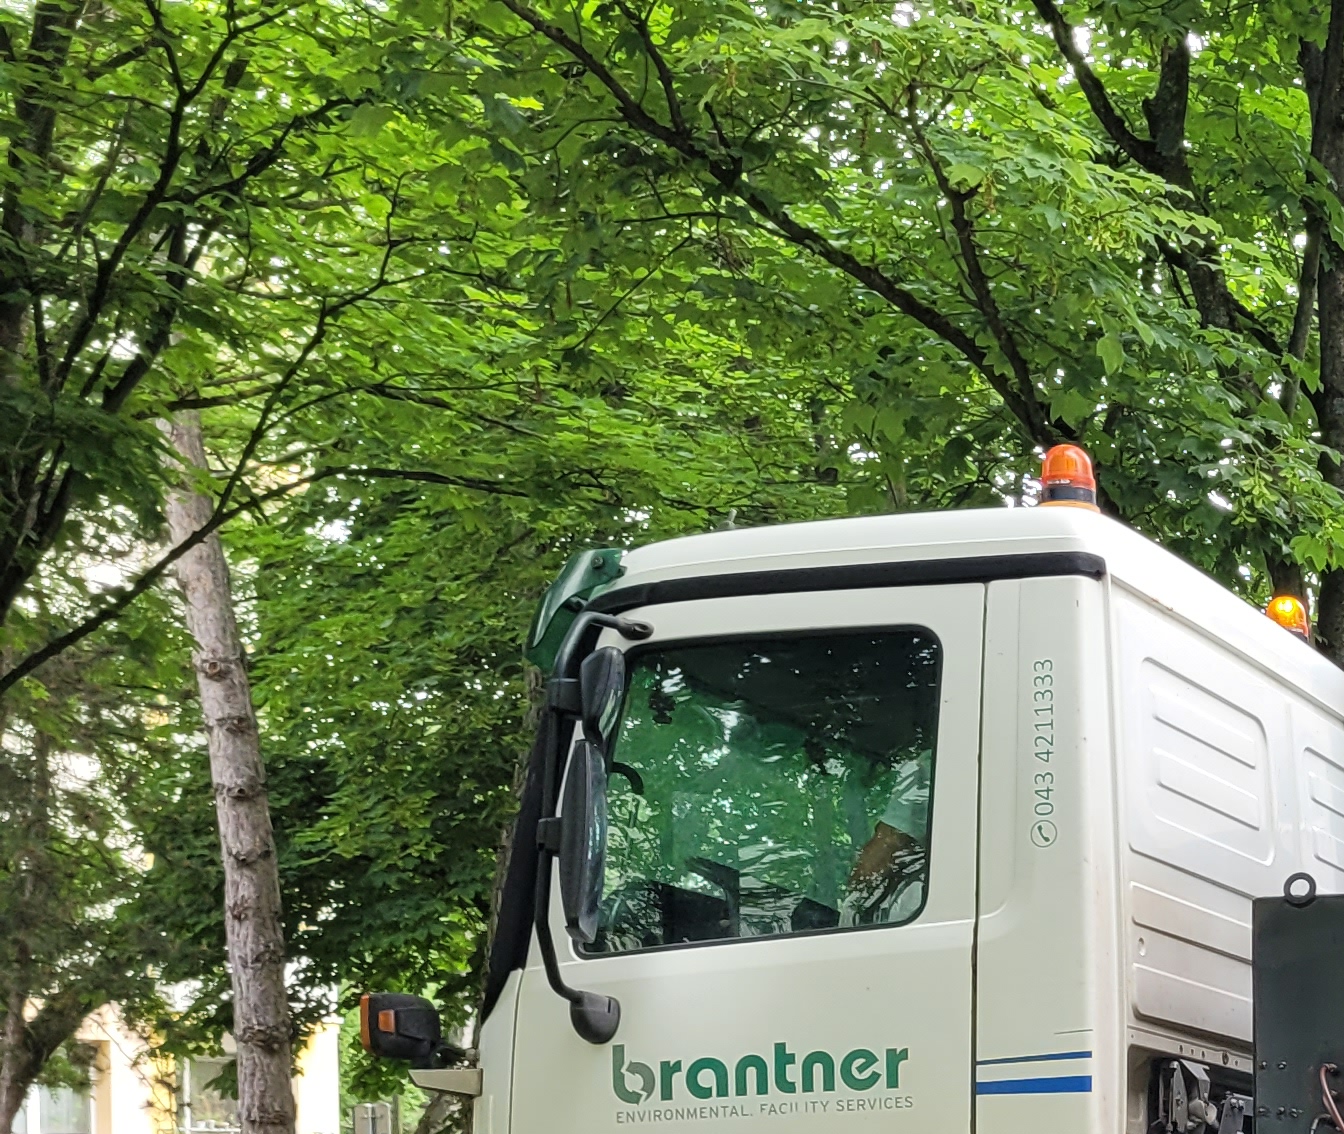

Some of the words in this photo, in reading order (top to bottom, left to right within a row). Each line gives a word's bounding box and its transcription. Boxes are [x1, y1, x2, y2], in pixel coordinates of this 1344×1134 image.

[1033, 659, 1054, 763] 4211333
[1034, 772, 1054, 816] 043
[612, 1042, 909, 1105] brantner
[836, 1096, 913, 1112] SERVICES
